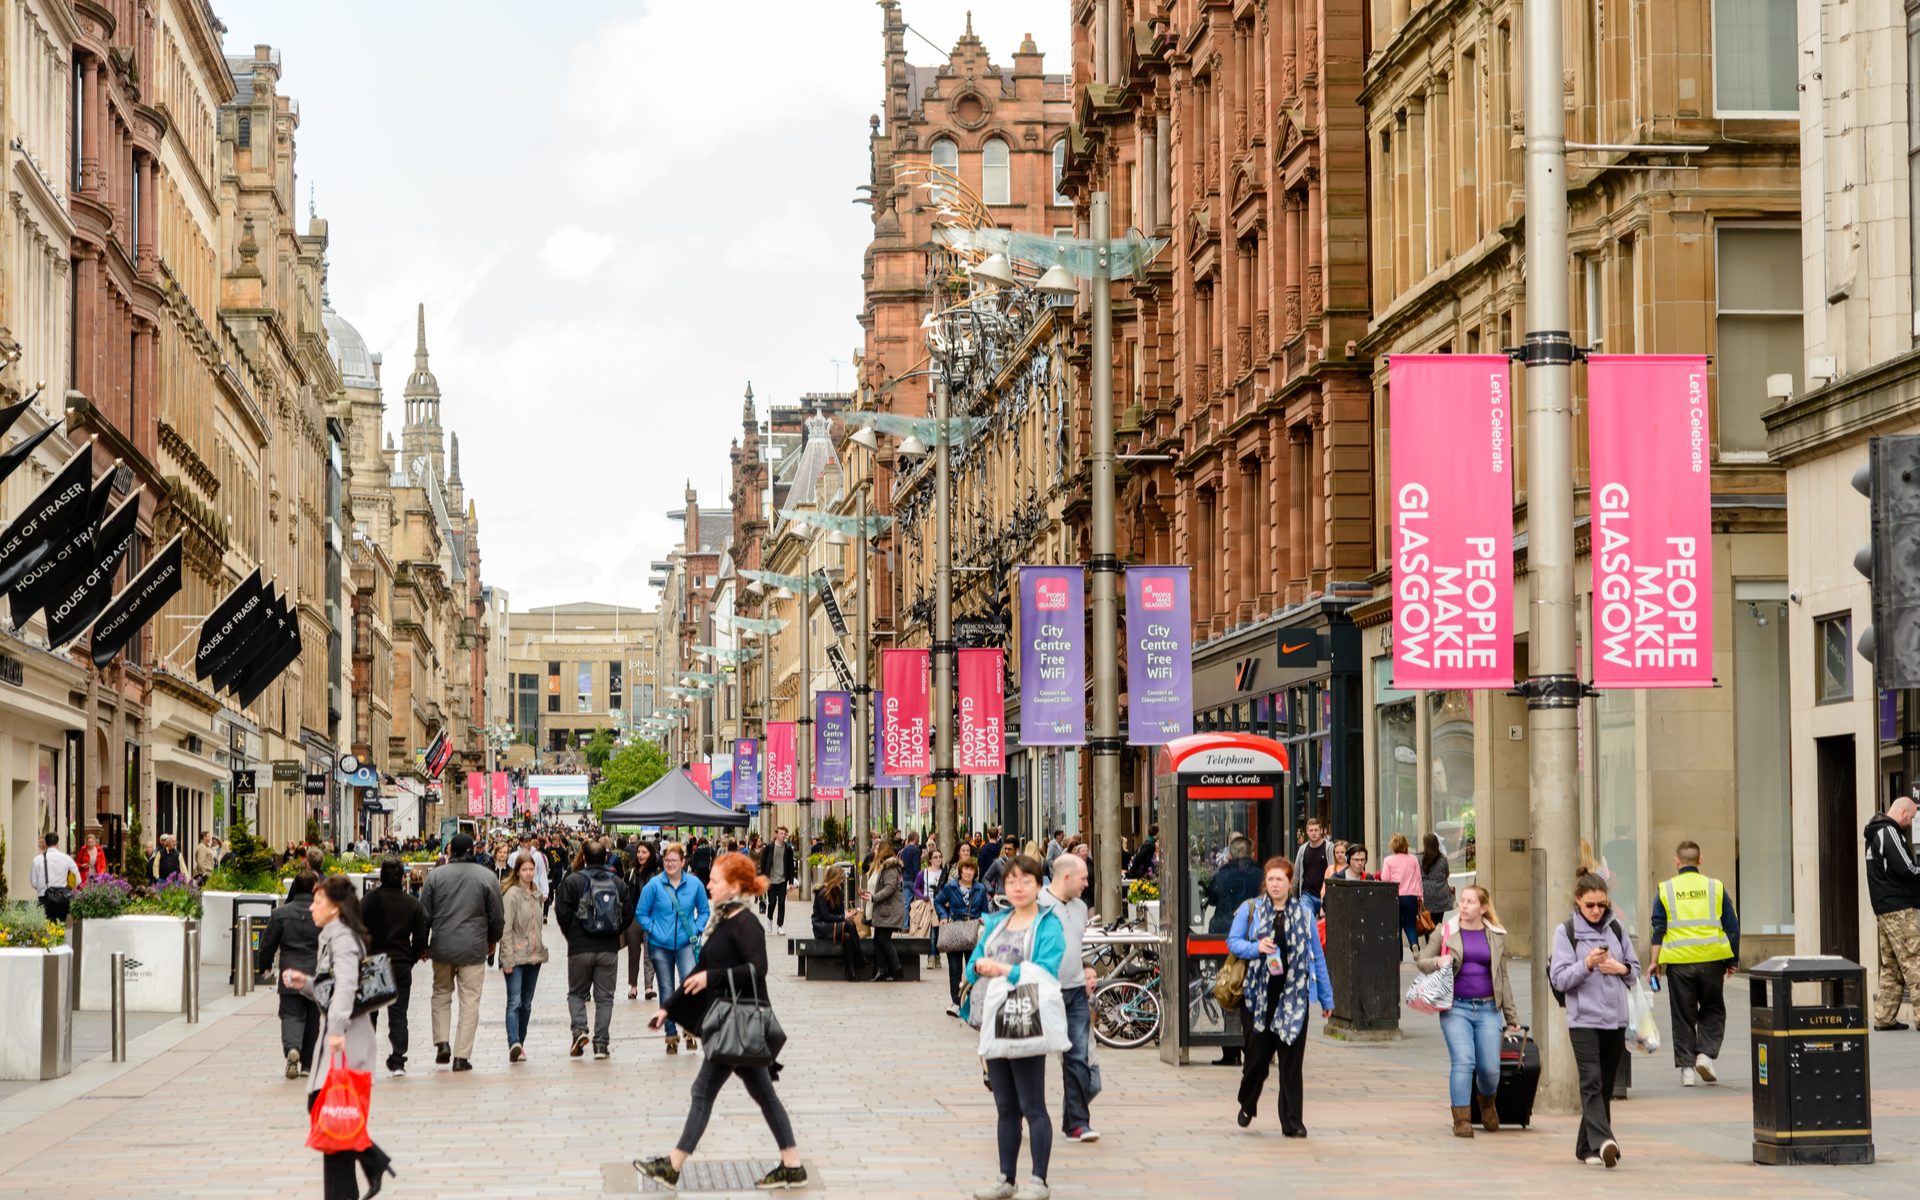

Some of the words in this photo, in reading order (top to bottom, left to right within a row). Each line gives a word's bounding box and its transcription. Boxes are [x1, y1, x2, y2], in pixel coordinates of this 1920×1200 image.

[1490, 374, 1502, 404] Let's
[1689, 374, 1701, 404] Let's
[1491, 408, 1504, 473] Celebrate
[1691, 408, 1703, 473] Celebrate
[22, 519, 39, 537] OF
[40, 482, 85, 522] FRASER
[15, 561, 56, 592] HOUSE
[57, 545, 73, 561] OF
[73, 520, 98, 548] FRA
[1399, 483, 1430, 668] GLASGOW
[1600, 483, 1631, 667] GLASGOW
[51, 585, 88, 623] HOUSE
[86, 568, 102, 587] OF
[96, 613, 129, 642] HOUSE
[130, 598, 141, 612] OF
[142, 565, 176, 597] FRASER
[1466, 538, 1496, 668] PEOPLE
[1666, 537, 1697, 667] PEOPLE
[198, 632, 224, 660] HOUSE
[222, 622, 233, 635] OF
[232, 595, 260, 624] FRASER
[1041, 625, 1064, 638] City
[1148, 625, 1170, 638] City
[1433, 566, 1463, 668] MAKE
[1634, 566, 1664, 667] MAKE
[1034, 639, 1071, 650] Centre
[1141, 639, 1178, 650] Centre
[1379, 625, 1393, 649] ZAR
[629, 660, 648, 671] John
[1040, 653, 1065, 665] Free
[1040, 668, 1066, 679] WiFi
[1147, 653, 1172, 665] Free
[1147, 668, 1172, 679] WiFi
[827, 722, 840, 731] City
[887, 697, 898, 767] GLASGOW
[962, 697, 974, 767] GLASGOW
[1053, 724, 1072, 733] wifi
[1161, 724, 1180, 733] wifi
[826, 745, 840, 753] WiFi
[900, 729, 911, 767] MAKE
[912, 718, 923, 767] PEOPLE
[975, 728, 986, 767] MAKE
[987, 717, 999, 767] PEOPLE
[1206, 754, 1255, 766] Telephone
[776, 772, 784, 796] MAKE
[1201, 775, 1224, 784] Coins
[1226, 775, 1234, 784] &
[1235, 775, 1260, 784] Cards
[1003, 1013, 1032, 1026] HOME
[1004, 996, 1032, 1014] BHS
[1810, 1016, 1842, 1024] LITTER
